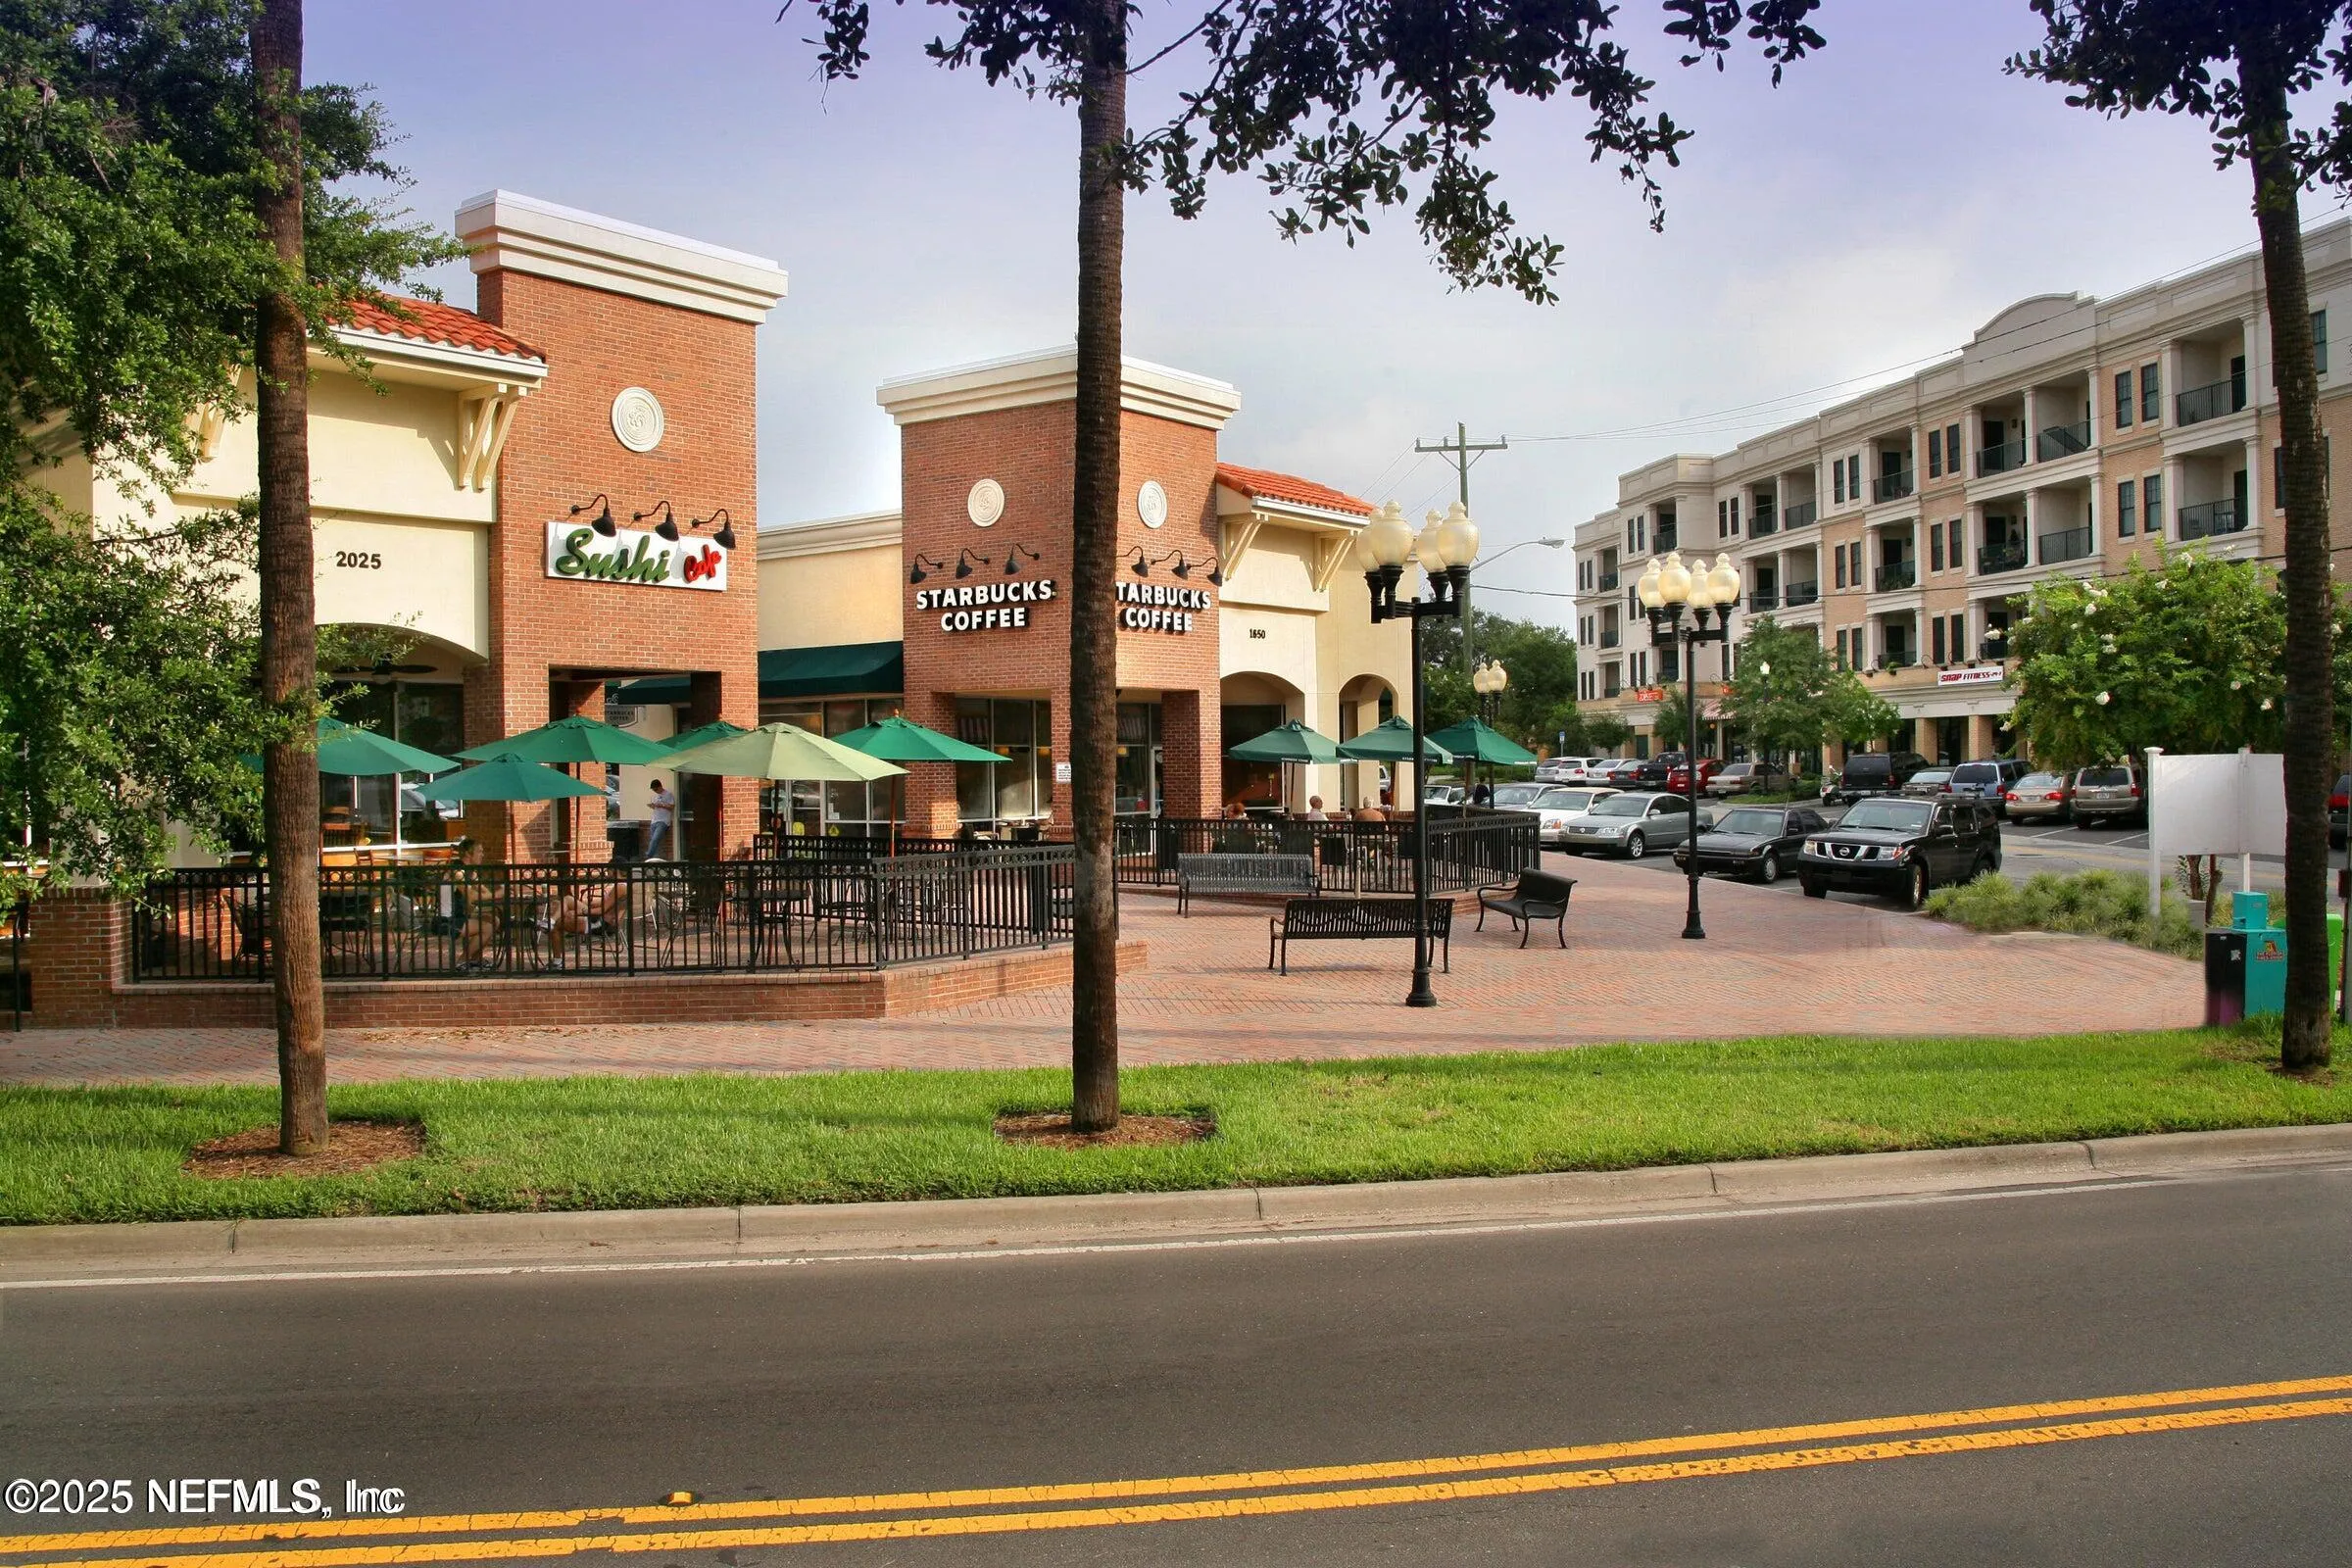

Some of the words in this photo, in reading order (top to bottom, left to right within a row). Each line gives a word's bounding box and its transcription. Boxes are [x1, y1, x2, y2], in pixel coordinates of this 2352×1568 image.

[335, 550, 382, 569] 2025
[556, 527, 670, 582] Sushi
[915, 579, 1055, 611] STARBUCKS
[1115, 581, 1212, 610] TARBUCKS
[940, 607, 1027, 632] COFFEE
[1124, 607, 1194, 632] COFFEE
